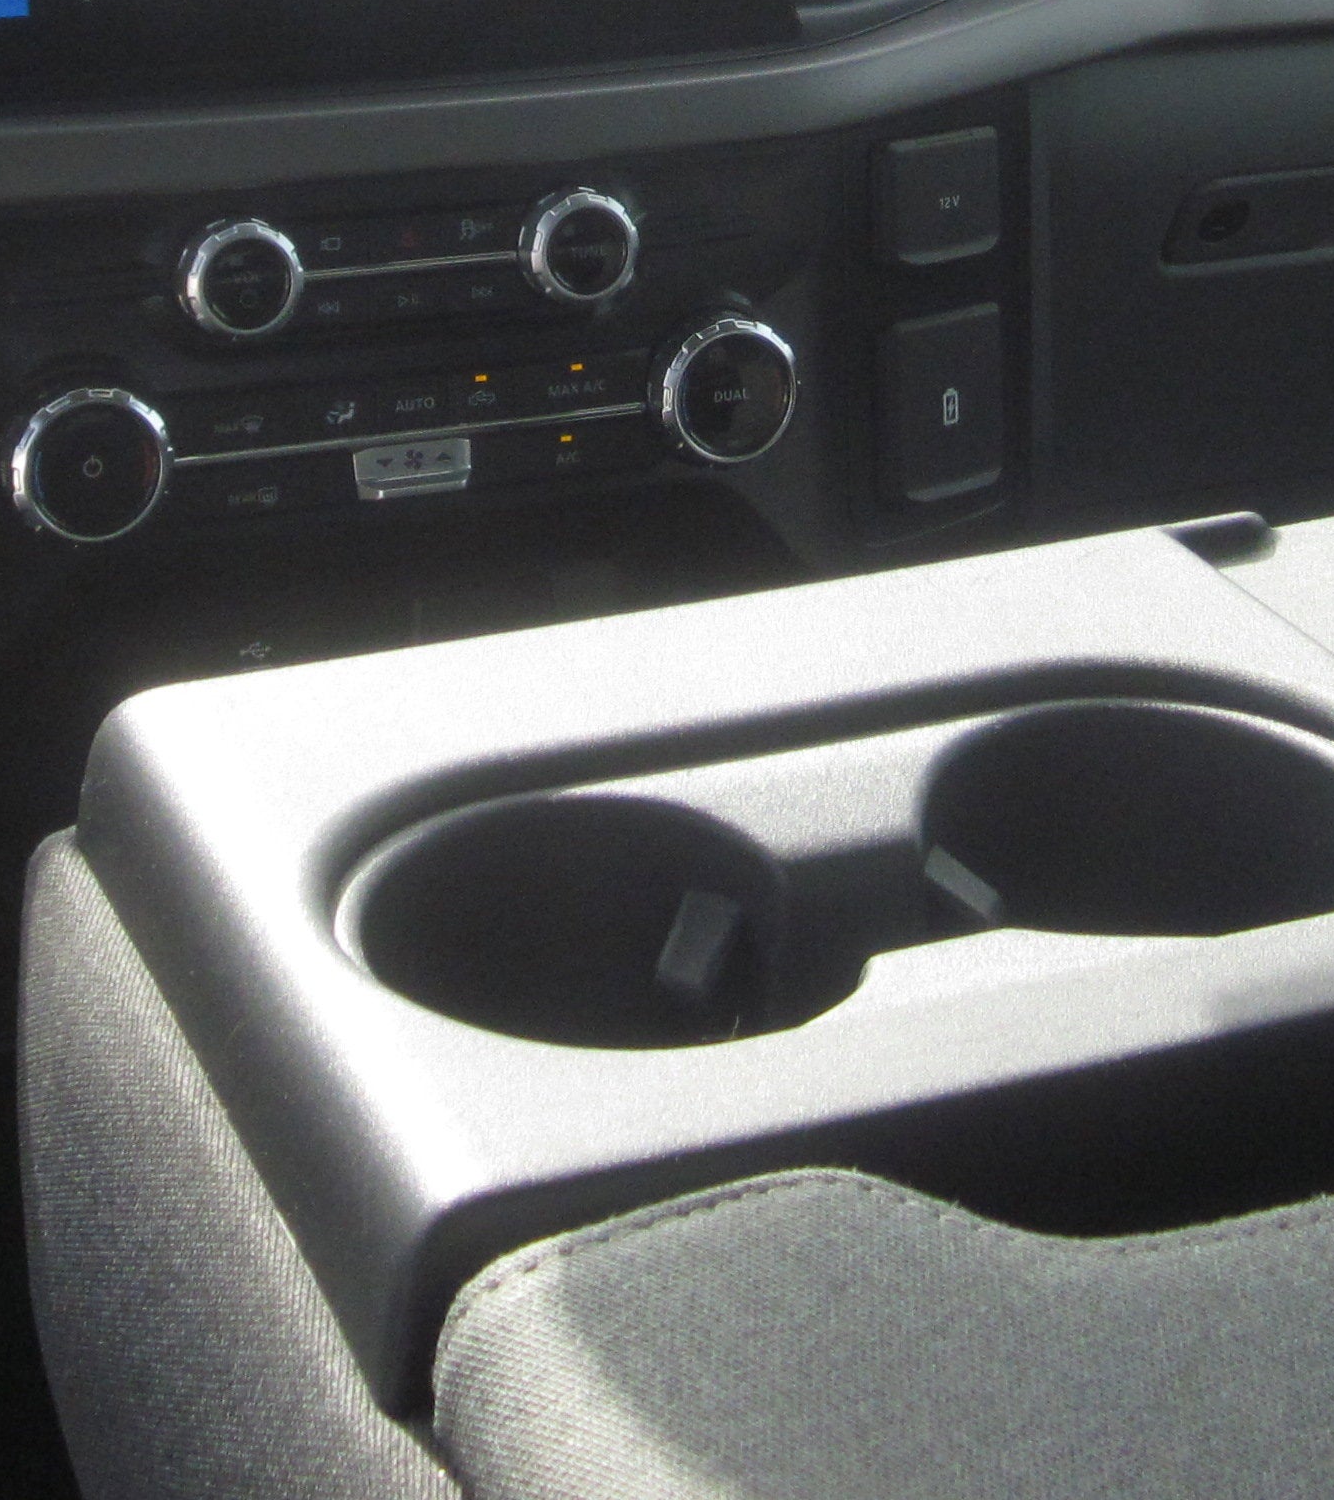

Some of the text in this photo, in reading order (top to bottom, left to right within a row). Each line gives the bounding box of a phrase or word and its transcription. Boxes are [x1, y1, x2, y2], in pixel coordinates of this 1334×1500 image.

[548, 379, 605, 397] MAX A/C
[713, 387, 749, 403] DUAL
[395, 397, 435, 413] AUTO
[556, 451, 579, 465] A/C
